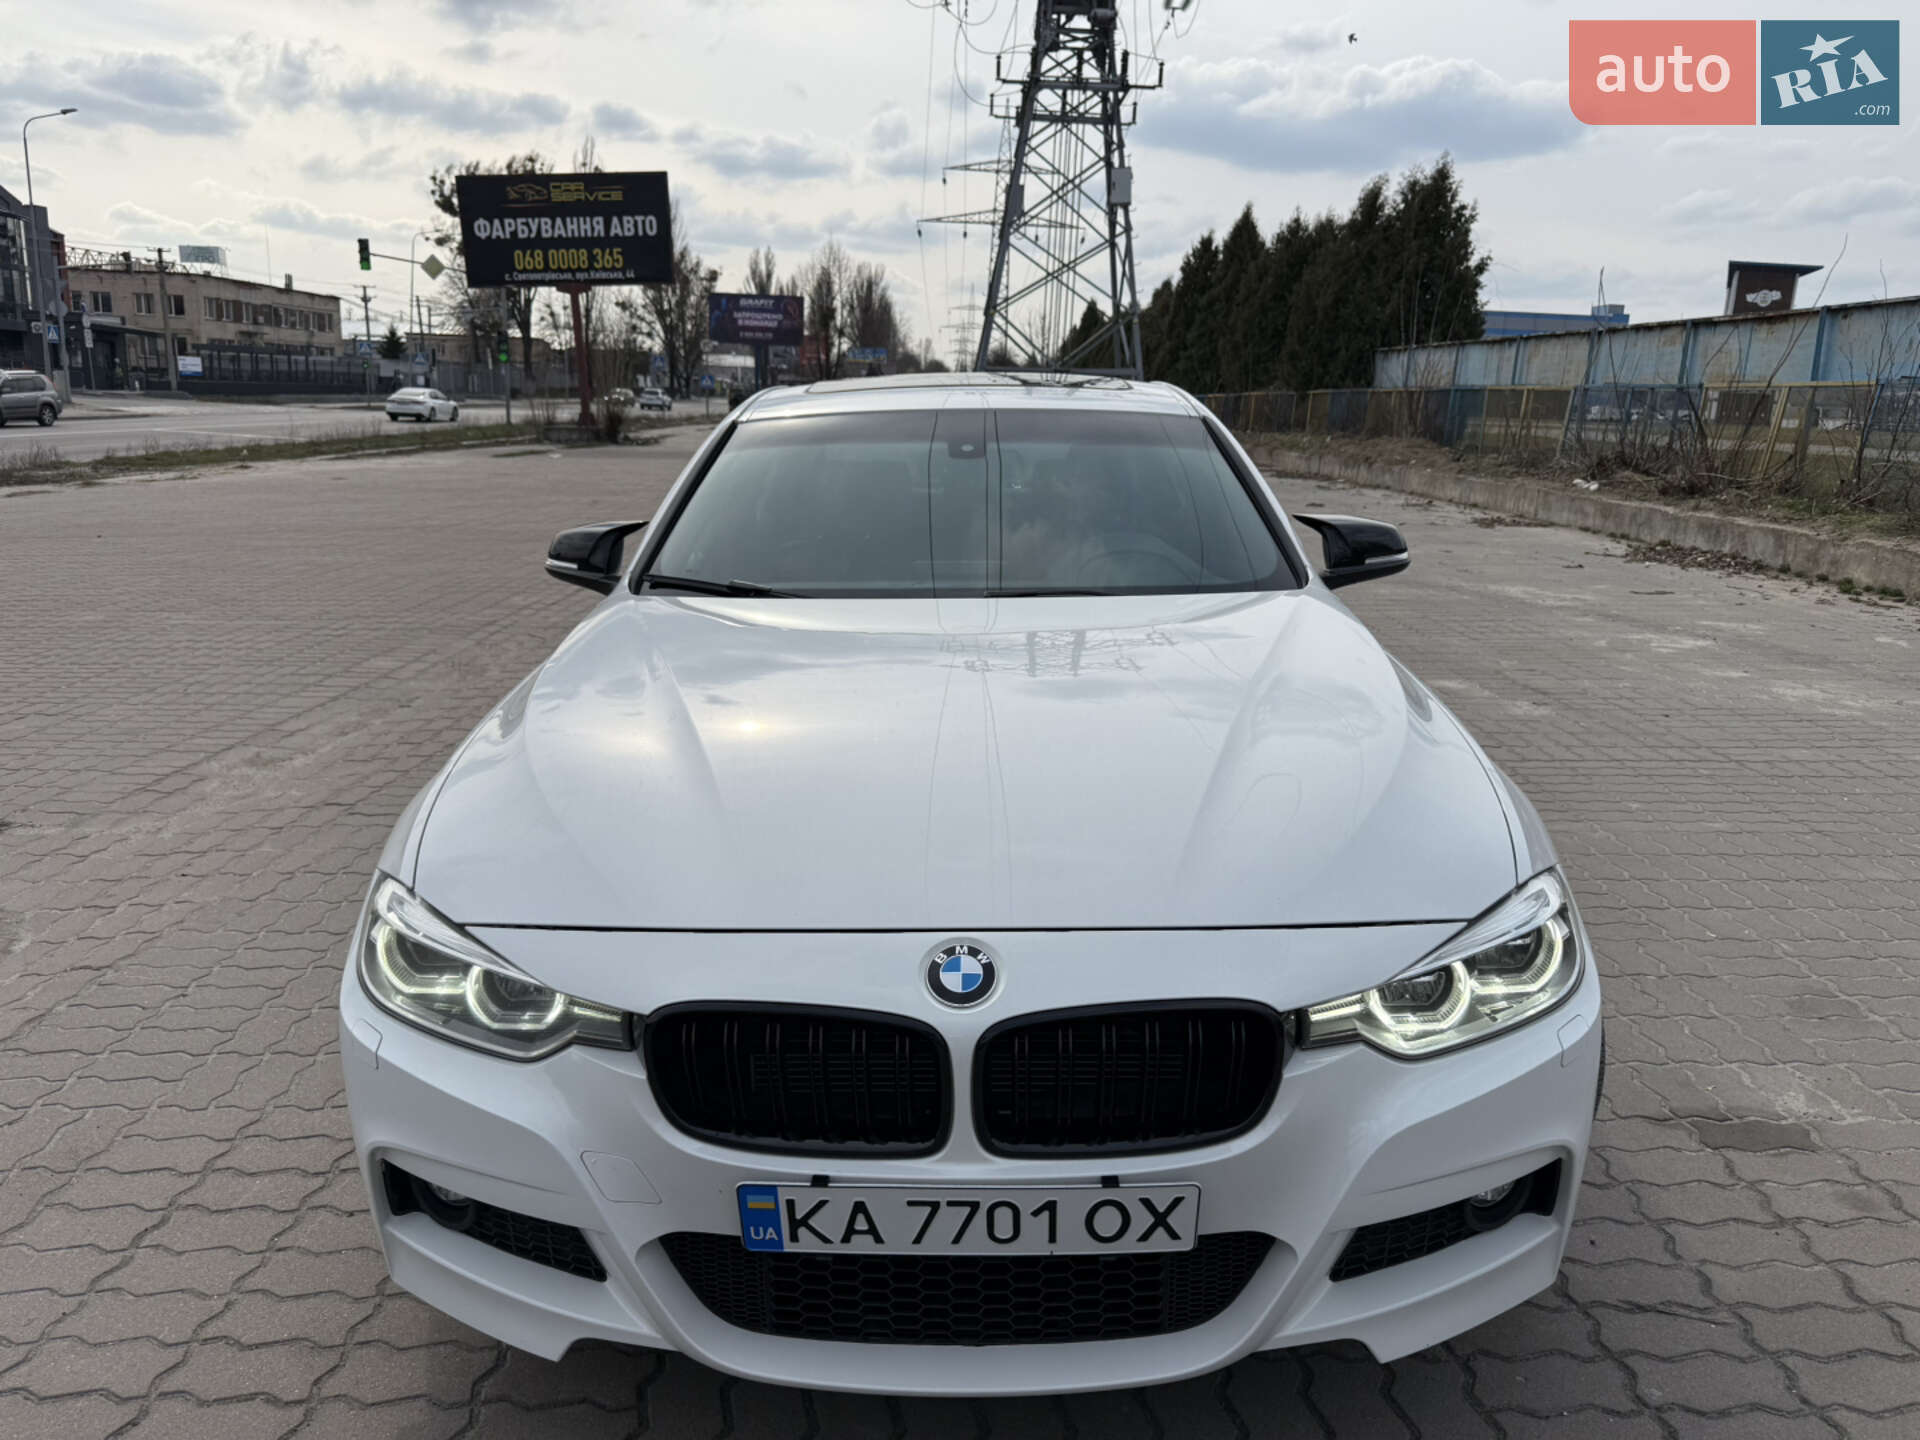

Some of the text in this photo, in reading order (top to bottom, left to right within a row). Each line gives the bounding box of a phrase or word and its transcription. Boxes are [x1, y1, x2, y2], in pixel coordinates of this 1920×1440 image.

[549, 182, 585, 192] CAR
[473, 214, 658, 240] ФАРБУВАННЯ АВТО
[513, 246, 624, 271] 068 0008 365
[934, 945, 991, 964] BMW
[785, 1196, 1186, 1245] KA 7701 OX
[750, 1226, 779, 1241] UA
